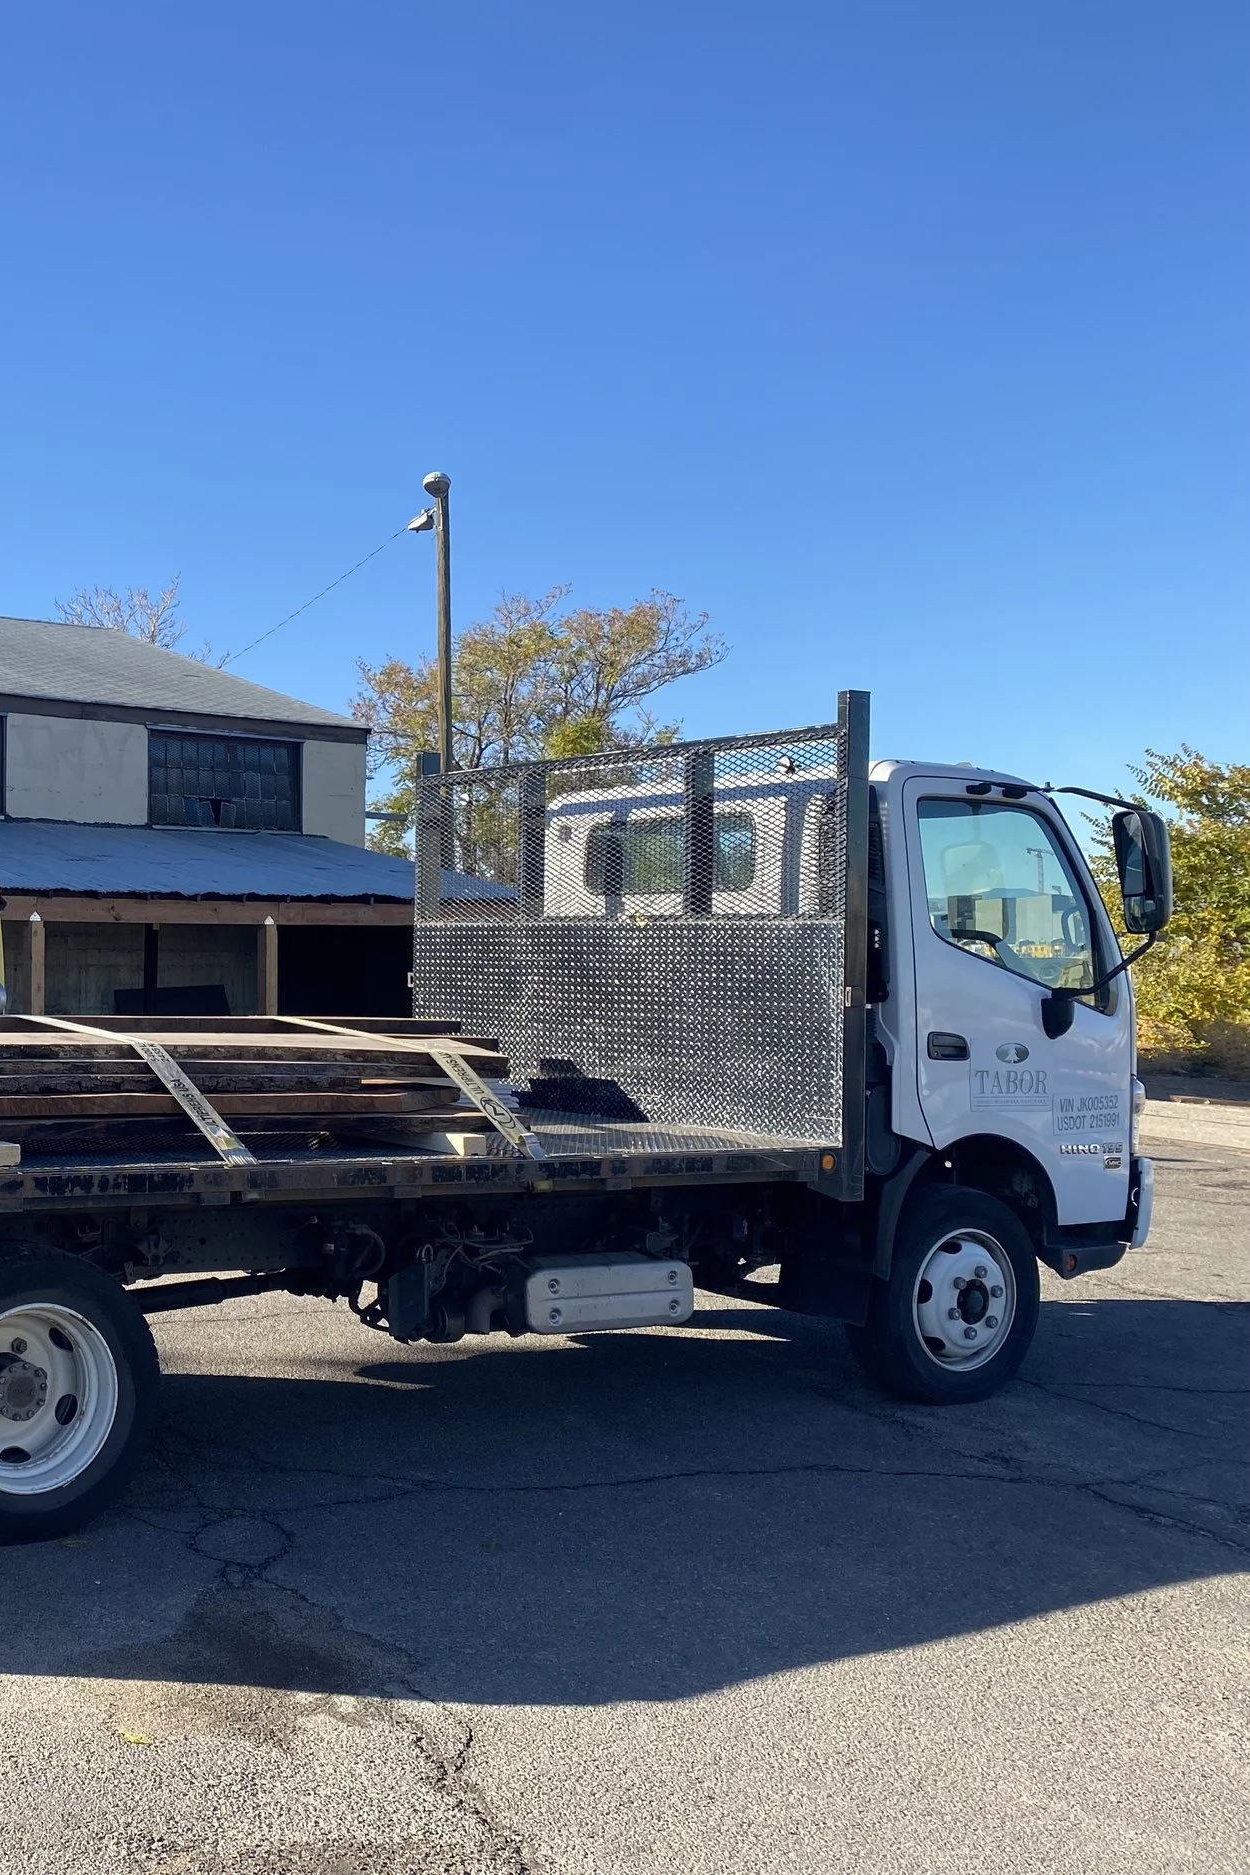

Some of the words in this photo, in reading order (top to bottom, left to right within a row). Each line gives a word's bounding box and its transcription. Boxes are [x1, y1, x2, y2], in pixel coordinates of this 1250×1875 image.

[170, 1078, 190, 1093] USA
[974, 1070, 1047, 1095] TABOR
[1059, 1098, 1075, 1113] VIN
[1077, 1094, 1119, 1112] JK005352
[1057, 1115, 1086, 1131] USDOT
[1089, 1112, 1120, 1129] 2151991
[1060, 1144, 1100, 1154] HINO
[1101, 1142, 1123, 1154] 195
